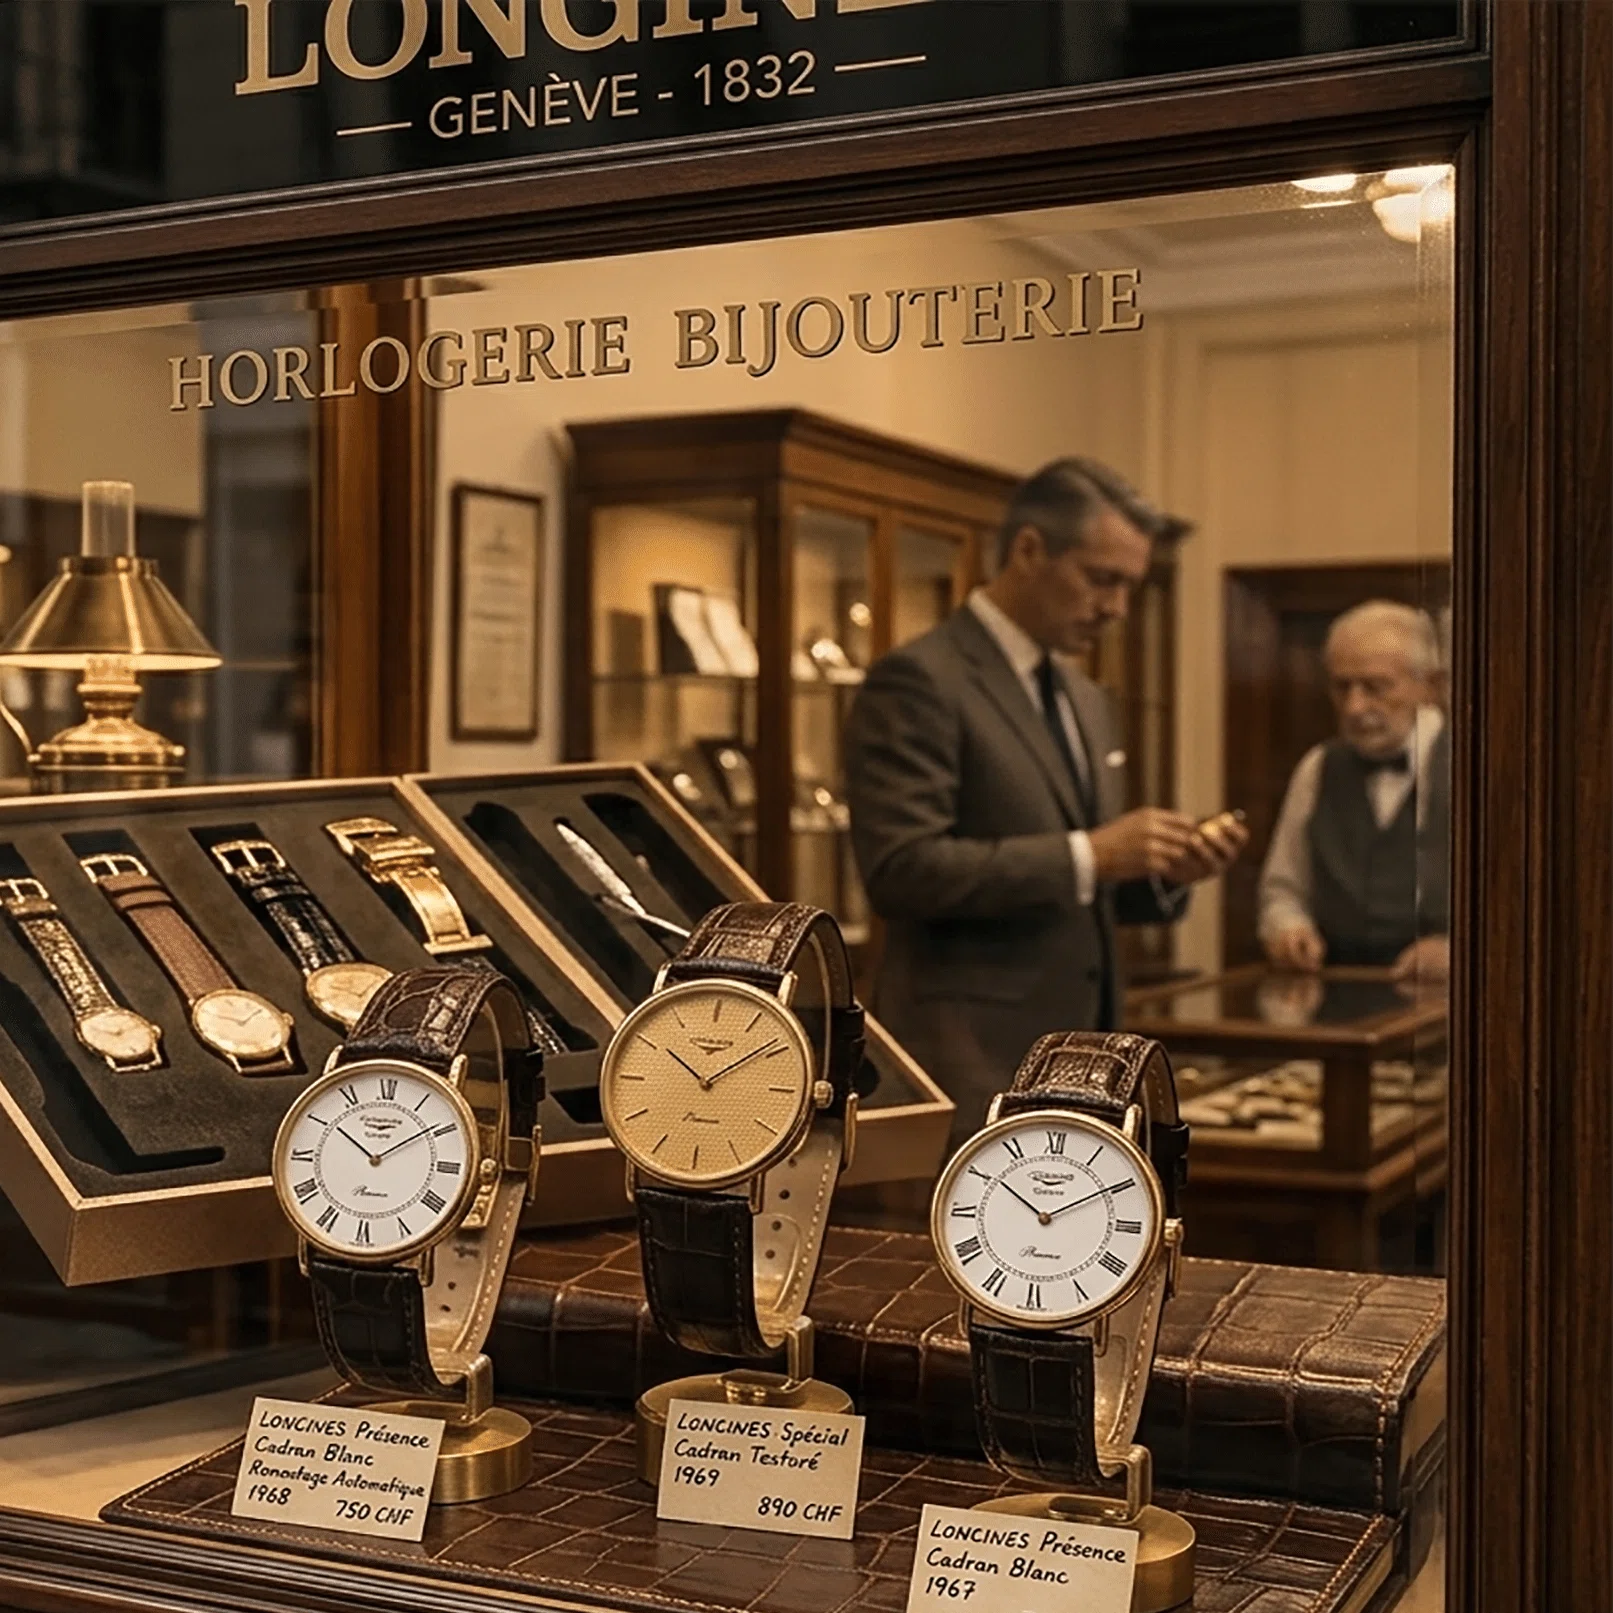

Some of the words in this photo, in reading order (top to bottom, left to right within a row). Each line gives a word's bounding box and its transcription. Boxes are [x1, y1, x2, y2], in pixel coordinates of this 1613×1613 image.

[428, 73, 639, 138] GENÈVE
[694, 50, 816, 106] 1832
[167, 316, 631, 410] HORLOGERIE
[673, 268, 1145, 378] BIJOUTERIE
[355, 1421, 430, 1448] Présence
[780, 1422, 849, 1447] Spécial
[254, 1435, 316, 1458] Cadran
[323, 1443, 374, 1466] Blanc
[674, 1438, 741, 1462] Cadran
[674, 1466, 720, 1487] 1969
[248, 1484, 292, 1505] 1968
[336, 1499, 371, 1520] 750
[758, 1496, 797, 1518] 890
[803, 1503, 843, 1522] CHF
[1039, 1531, 1126, 1564] Présence
[926, 1547, 999, 1575] Cadran
[1009, 1557, 1069, 1584] Blanc
[925, 1576, 976, 1600] 1967
